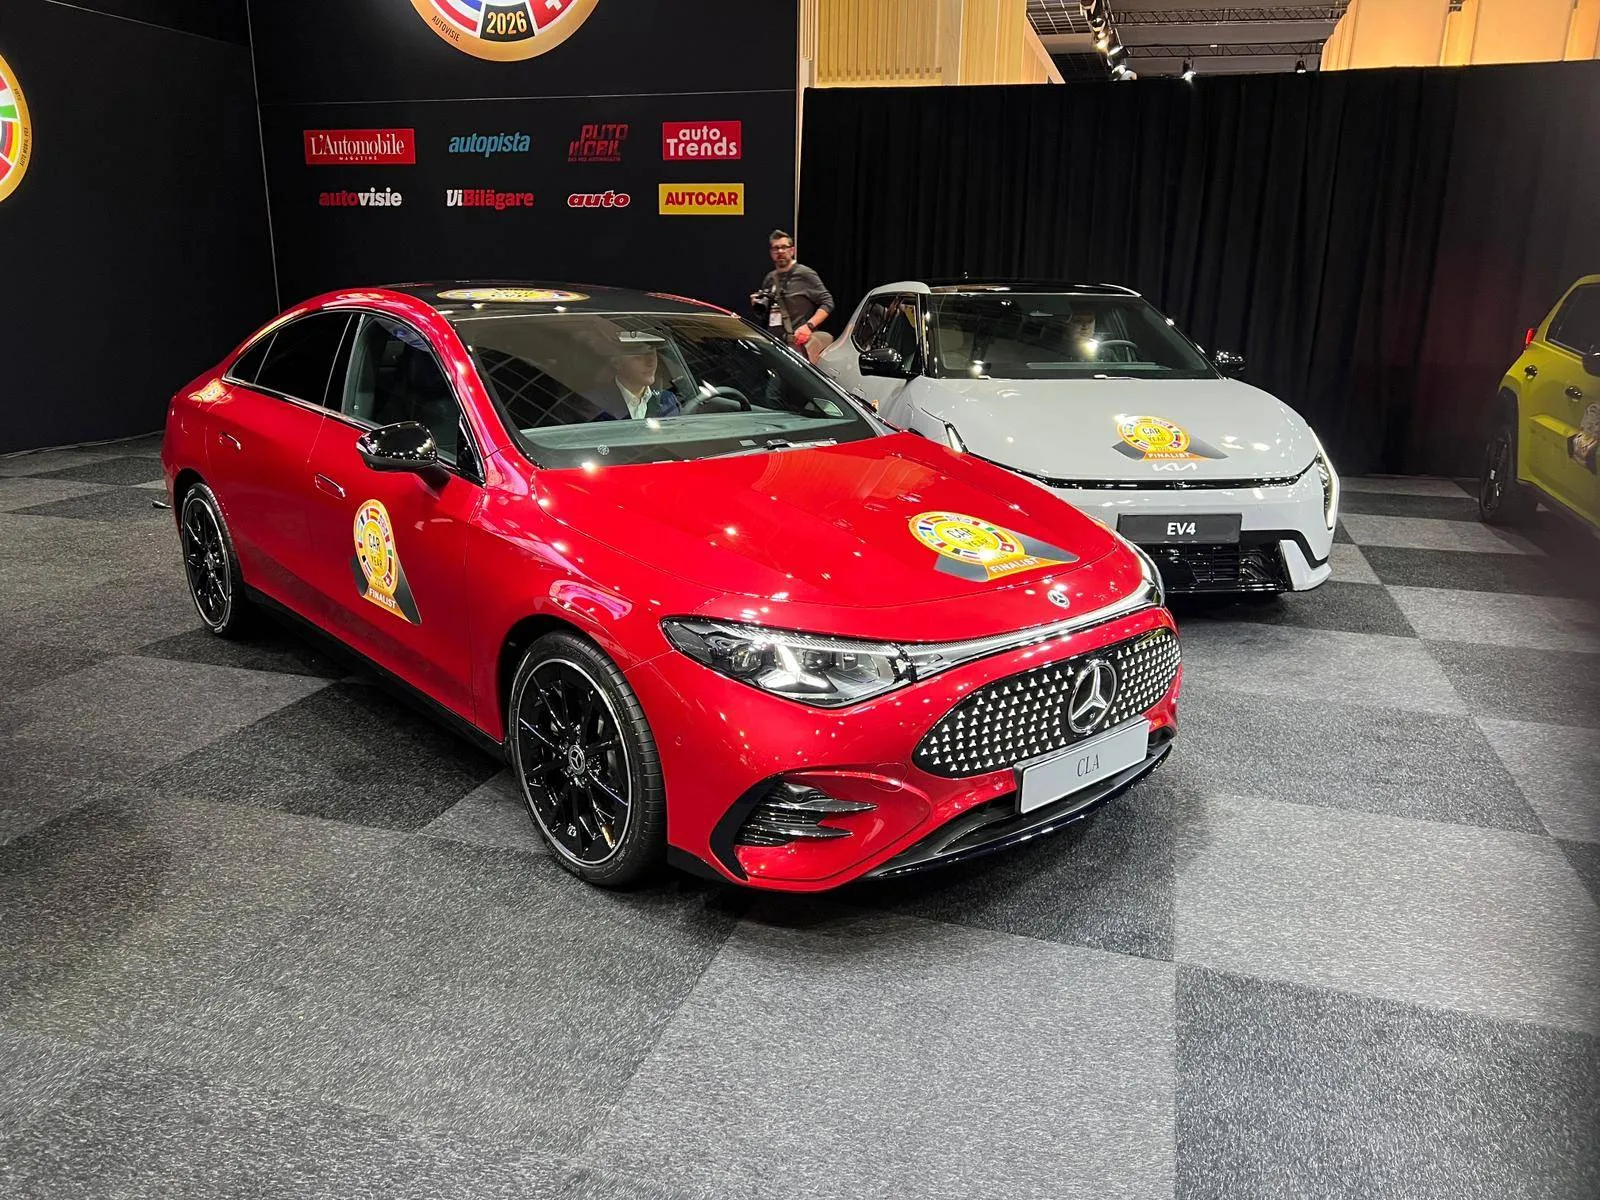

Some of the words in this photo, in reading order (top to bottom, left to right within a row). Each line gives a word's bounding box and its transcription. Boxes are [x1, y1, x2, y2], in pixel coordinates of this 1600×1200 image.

[431, 14, 461, 43] AUTOVISIE
[486, 10, 528, 36] 2026
[678, 125, 721, 140] auto
[310, 133, 405, 156] L'Automobile
[448, 130, 531, 158] autopista
[666, 137, 738, 157] Trends
[318, 187, 403, 207] autovisie
[567, 190, 631, 208] auto
[664, 191, 738, 206] AUTOCAR
[1142, 427, 1161, 436] CAR
[946, 527, 974, 539] CAR
[1166, 522, 1197, 536] EV4
[989, 556, 1038, 574] FINALIST
[369, 587, 397, 609] FINALIST
[1077, 753, 1100, 777] CLA
